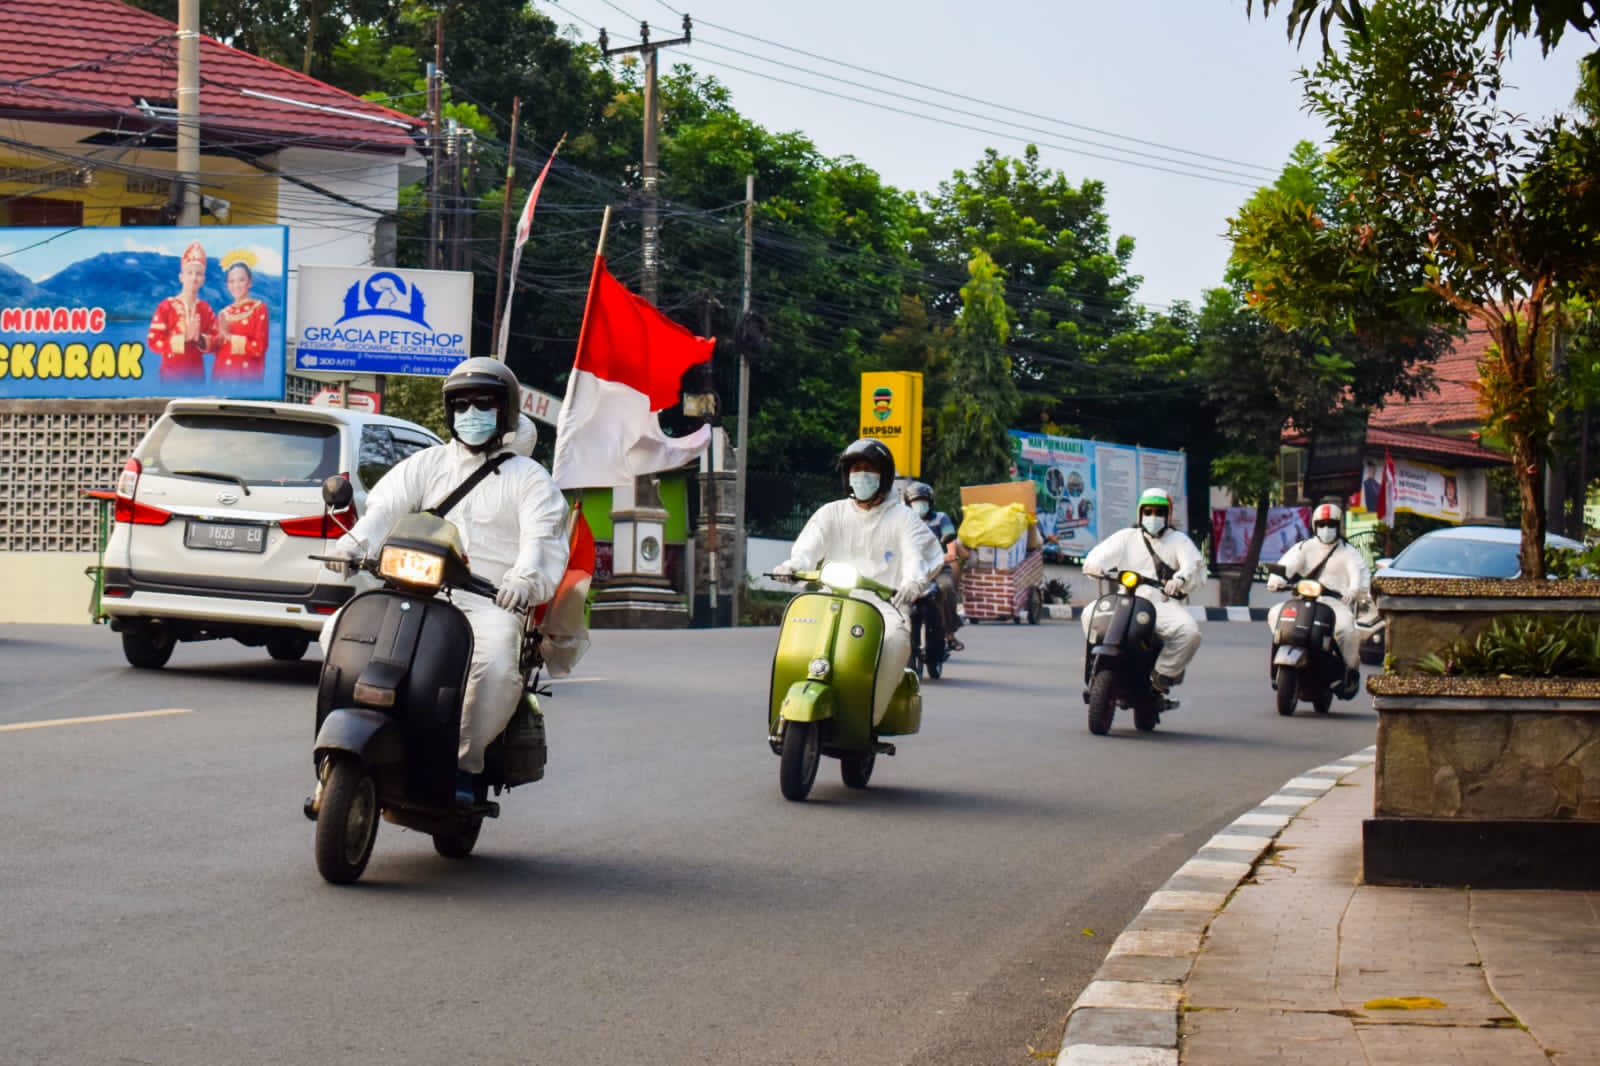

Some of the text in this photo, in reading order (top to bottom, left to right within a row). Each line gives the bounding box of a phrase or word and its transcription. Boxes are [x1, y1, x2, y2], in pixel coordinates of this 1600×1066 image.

[2, 307, 106, 333] MINANG
[304, 326, 463, 348] GRACIA PETSHOP
[300, 340, 337, 349] PETSHOP
[344, 342, 393, 352] GROOMING
[400, 345, 434, 354] DOKTER
[862, 425, 902, 435] BKPSDM
